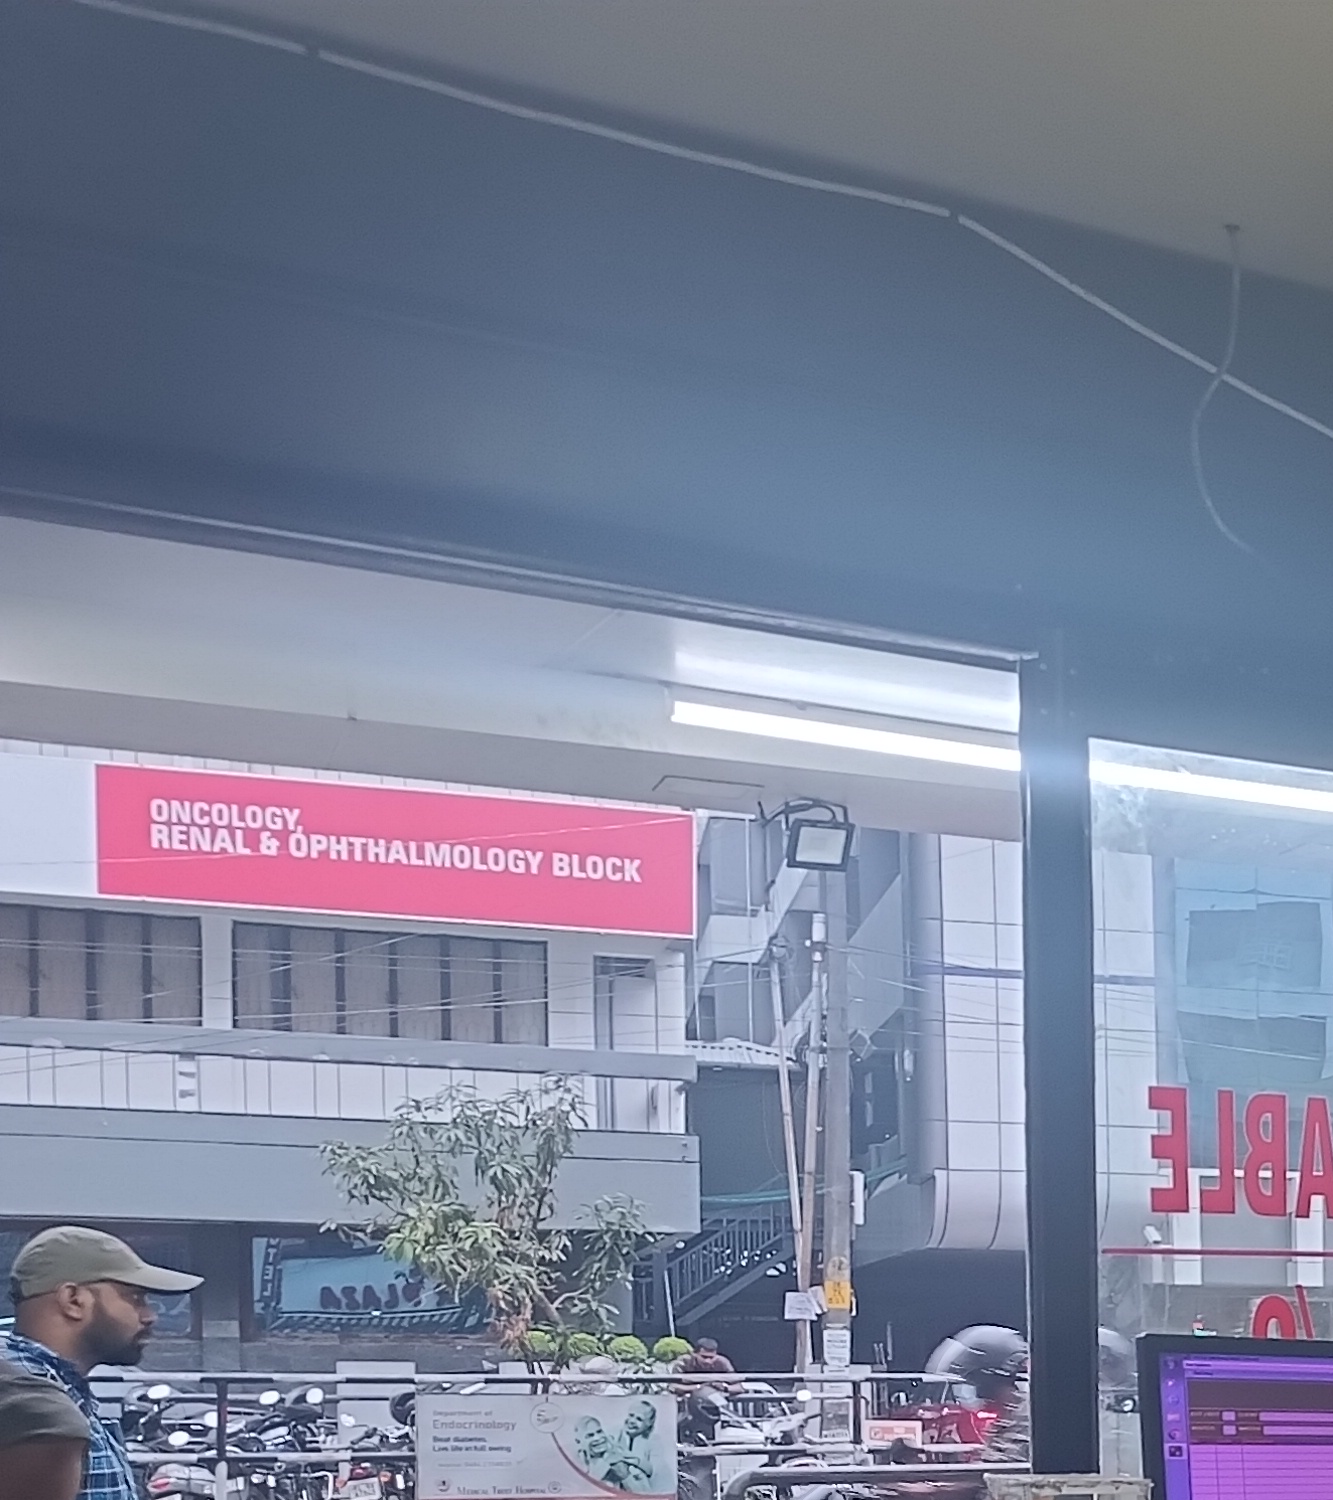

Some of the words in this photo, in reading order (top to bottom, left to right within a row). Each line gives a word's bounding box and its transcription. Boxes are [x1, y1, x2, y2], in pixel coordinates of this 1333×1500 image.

[150, 798, 303, 834] ONCOLOGY,
[150, 823, 252, 857] RENAL
[259, 828, 280, 857] &
[287, 830, 544, 877] OPHTHALMOLOGY
[552, 852, 643, 884] BLOCK
[433, 1419, 517, 1431] Endocrinology
